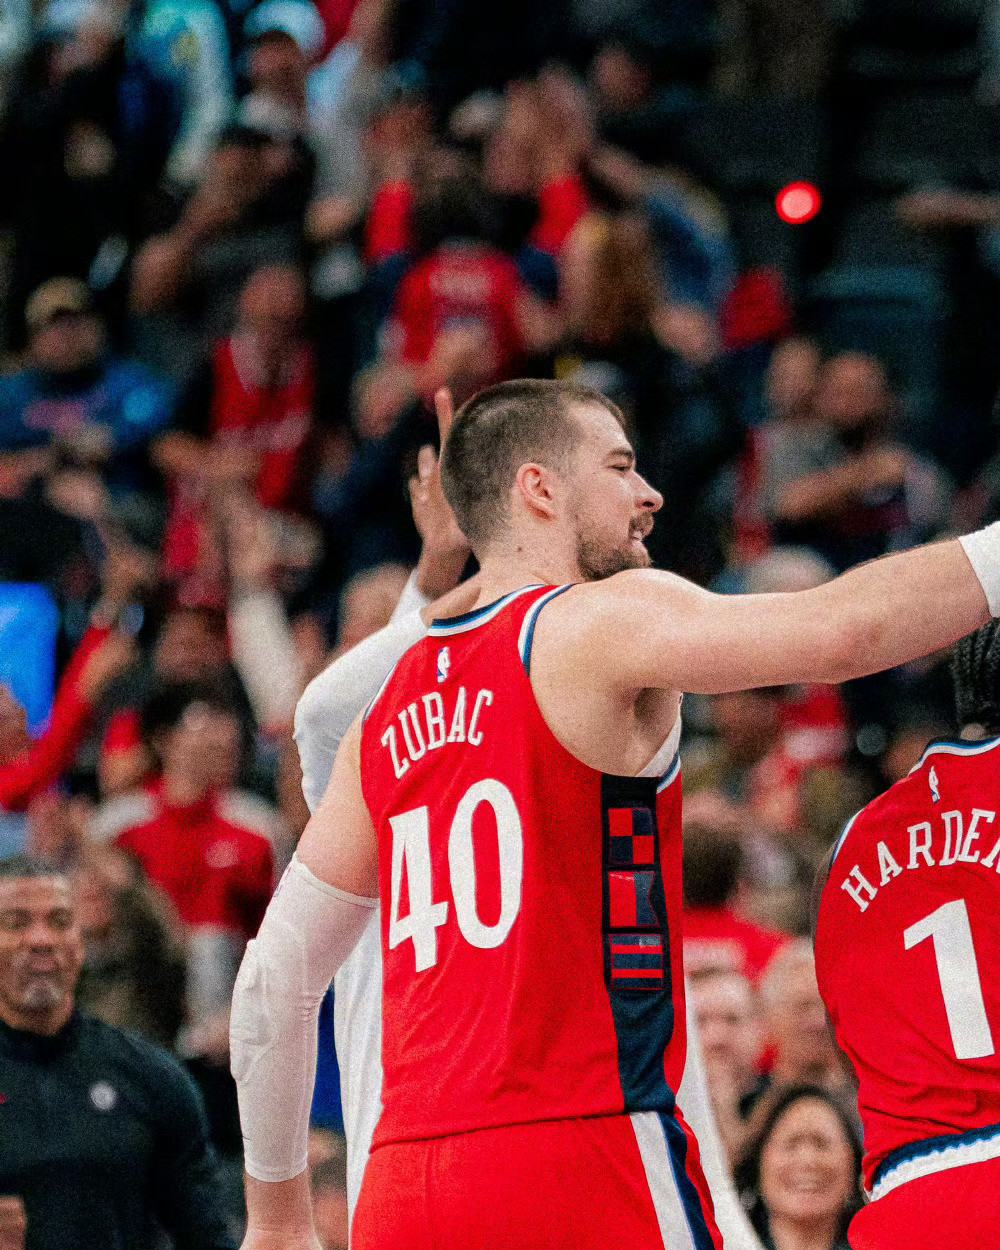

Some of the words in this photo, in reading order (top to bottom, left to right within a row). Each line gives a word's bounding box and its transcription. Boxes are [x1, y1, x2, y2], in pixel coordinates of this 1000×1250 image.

[381, 686, 494, 779] ZUBAC
[388, 778, 524, 973] 40
[903, 898, 995, 1060] 1
